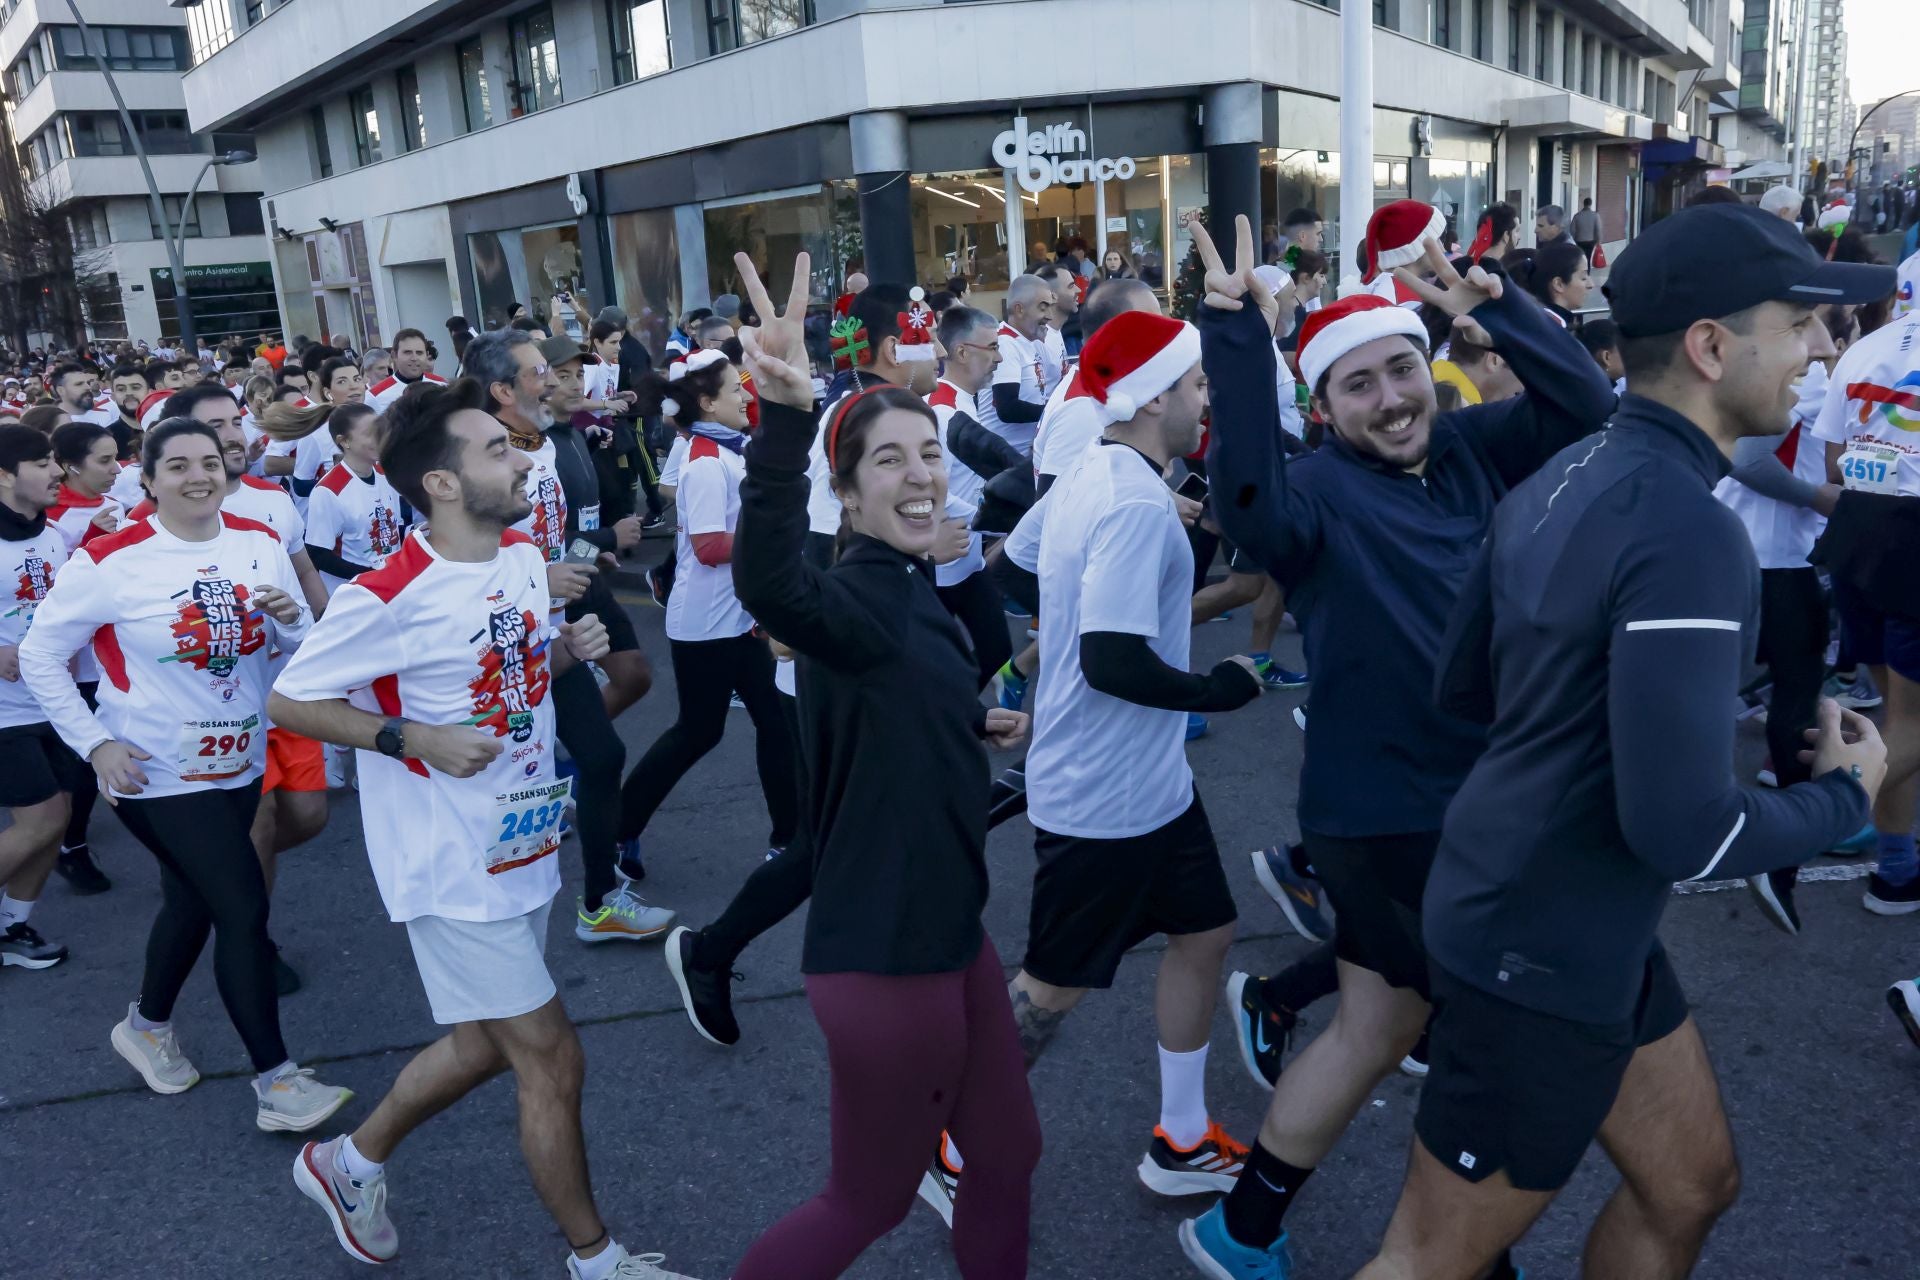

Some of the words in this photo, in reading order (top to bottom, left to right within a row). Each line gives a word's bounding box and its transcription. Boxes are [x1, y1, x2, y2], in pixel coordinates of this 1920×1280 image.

[992, 117, 1086, 168] delfín
[1017, 155, 1136, 193] blanco
[206, 264, 248, 275] Asistencial
[1844, 457, 1887, 482] 2517
[200, 591, 237, 607] SAN
[209, 581, 234, 595] 55
[206, 605, 240, 623] SIL
[502, 608, 524, 631] 55
[208, 622, 243, 640] VES
[496, 624, 526, 648] SAN
[207, 638, 242, 658] TRE
[501, 660, 525, 690] VES
[499, 683, 531, 712] TRE
[200, 721, 211, 729] 55
[212, 720, 229, 728] SAN
[198, 731, 251, 757] 290
[510, 792, 520, 802] 55
[520, 789, 535, 800] SAN
[536, 780, 569, 798] SILVESTRE
[499, 800, 562, 842] 2433
